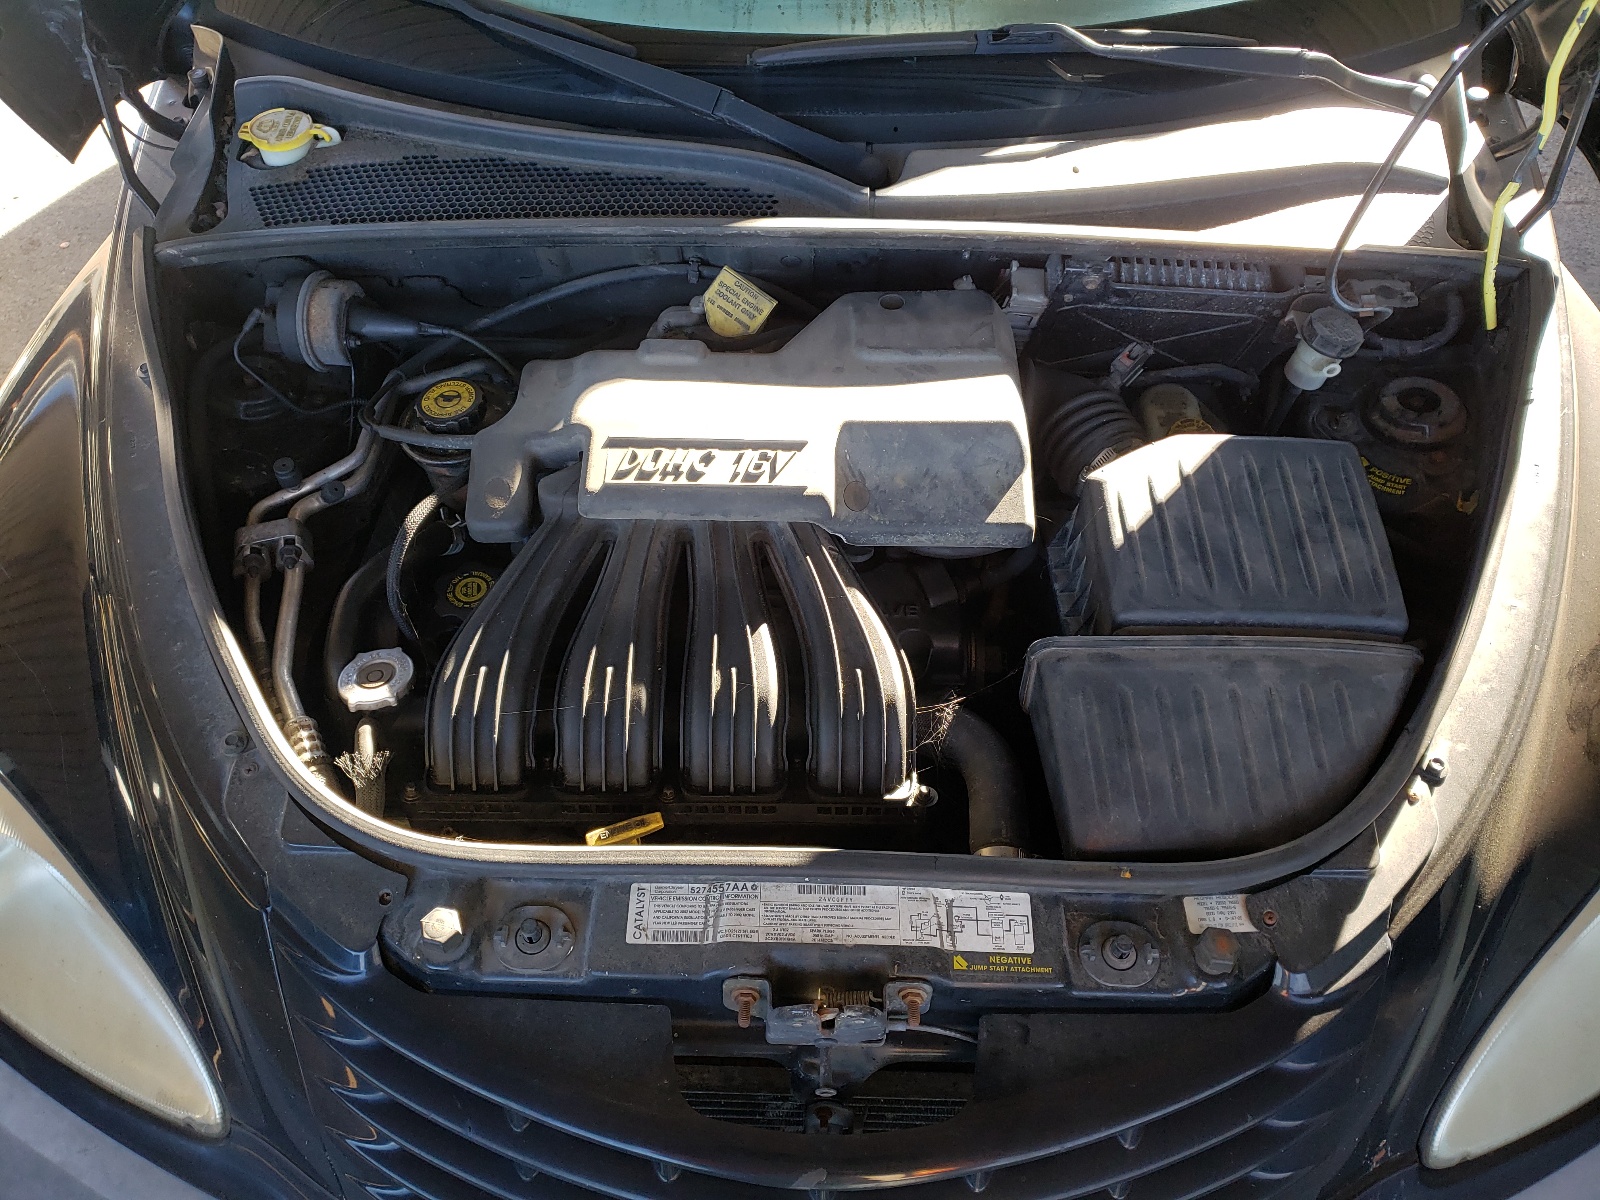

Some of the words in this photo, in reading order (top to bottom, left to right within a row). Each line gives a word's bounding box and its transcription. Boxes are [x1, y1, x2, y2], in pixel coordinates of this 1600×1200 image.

[718, 280, 742, 300] SPECIAL
[741, 297, 764, 316] ENGINE
[734, 280, 760, 300] CAUTION
[714, 289, 742, 310] COOLANT
[740, 307, 757, 320] ONLY
[610, 449, 717, 483] DOHC
[728, 450, 797, 484] 16V
[1369, 466, 1413, 485] POSITIVE
[1367, 474, 1386, 484] JUMP
[1386, 482, 1408, 490] START
[1368, 479, 1406, 496] TACHMENT
[600, 821, 632, 840] ENGINE
[690, 882, 749, 894] 5274557AA
[632, 886, 646, 940] CATALYST
[989, 955, 1032, 965] NEGATIVE
[1010, 966, 1053, 974] ATTACHMENT
